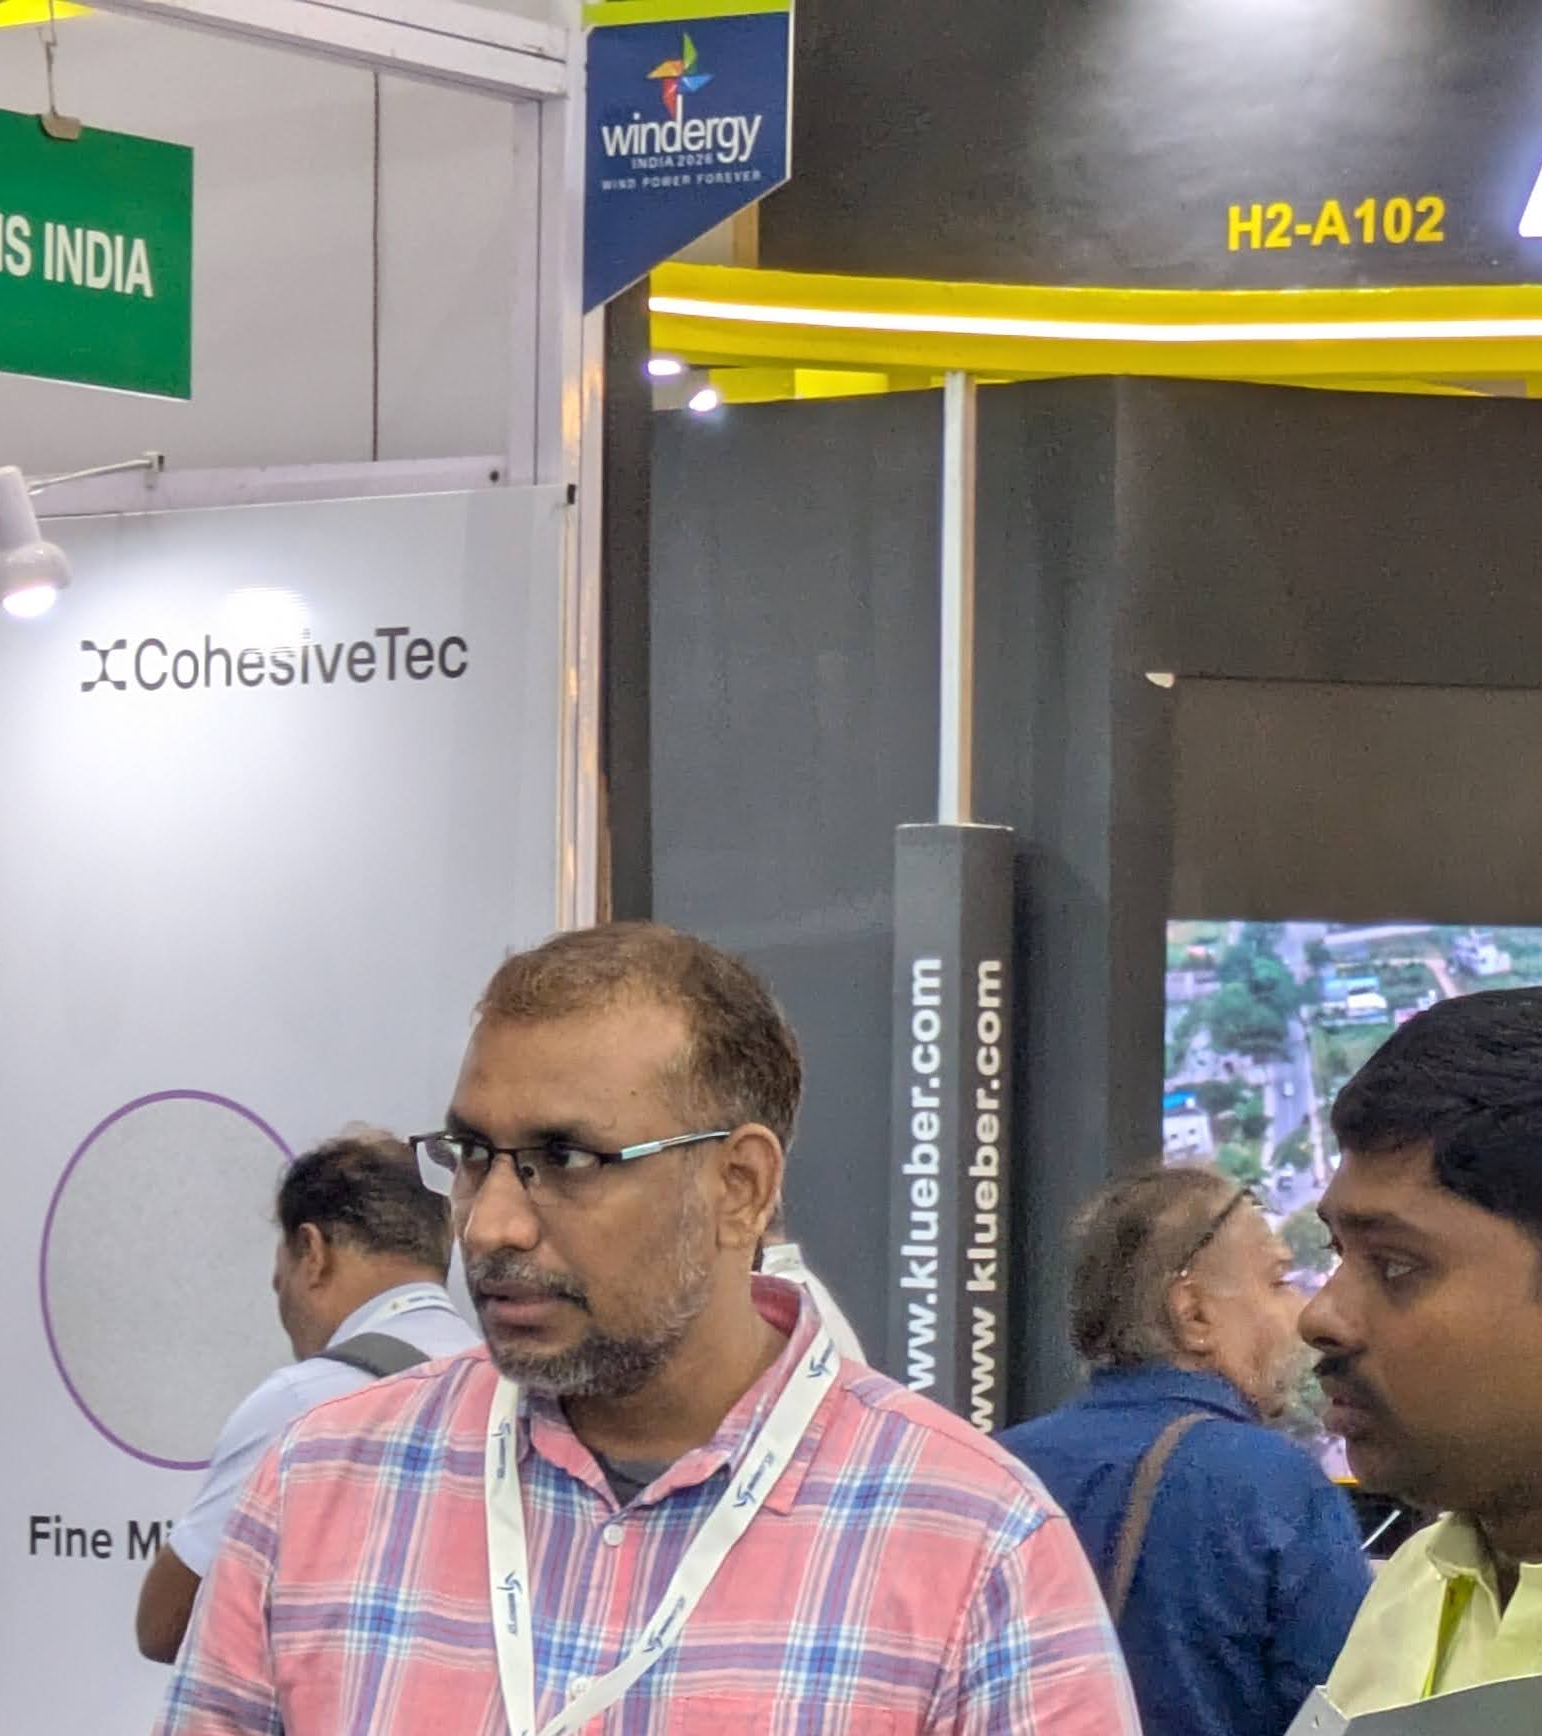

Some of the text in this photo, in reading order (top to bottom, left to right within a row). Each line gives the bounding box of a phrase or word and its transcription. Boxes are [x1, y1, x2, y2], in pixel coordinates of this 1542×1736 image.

[602, 93, 763, 164] windergy
[632, 155, 674, 169] INDIA
[642, 175, 691, 189] POWER
[696, 169, 762, 186] FOREVER
[1226, 196, 1446, 253] H2-A102
[43, 227, 155, 300] INDIA
[133, 626, 469, 692] CohesiveTec
[29, 1514, 113, 1559] Fine
